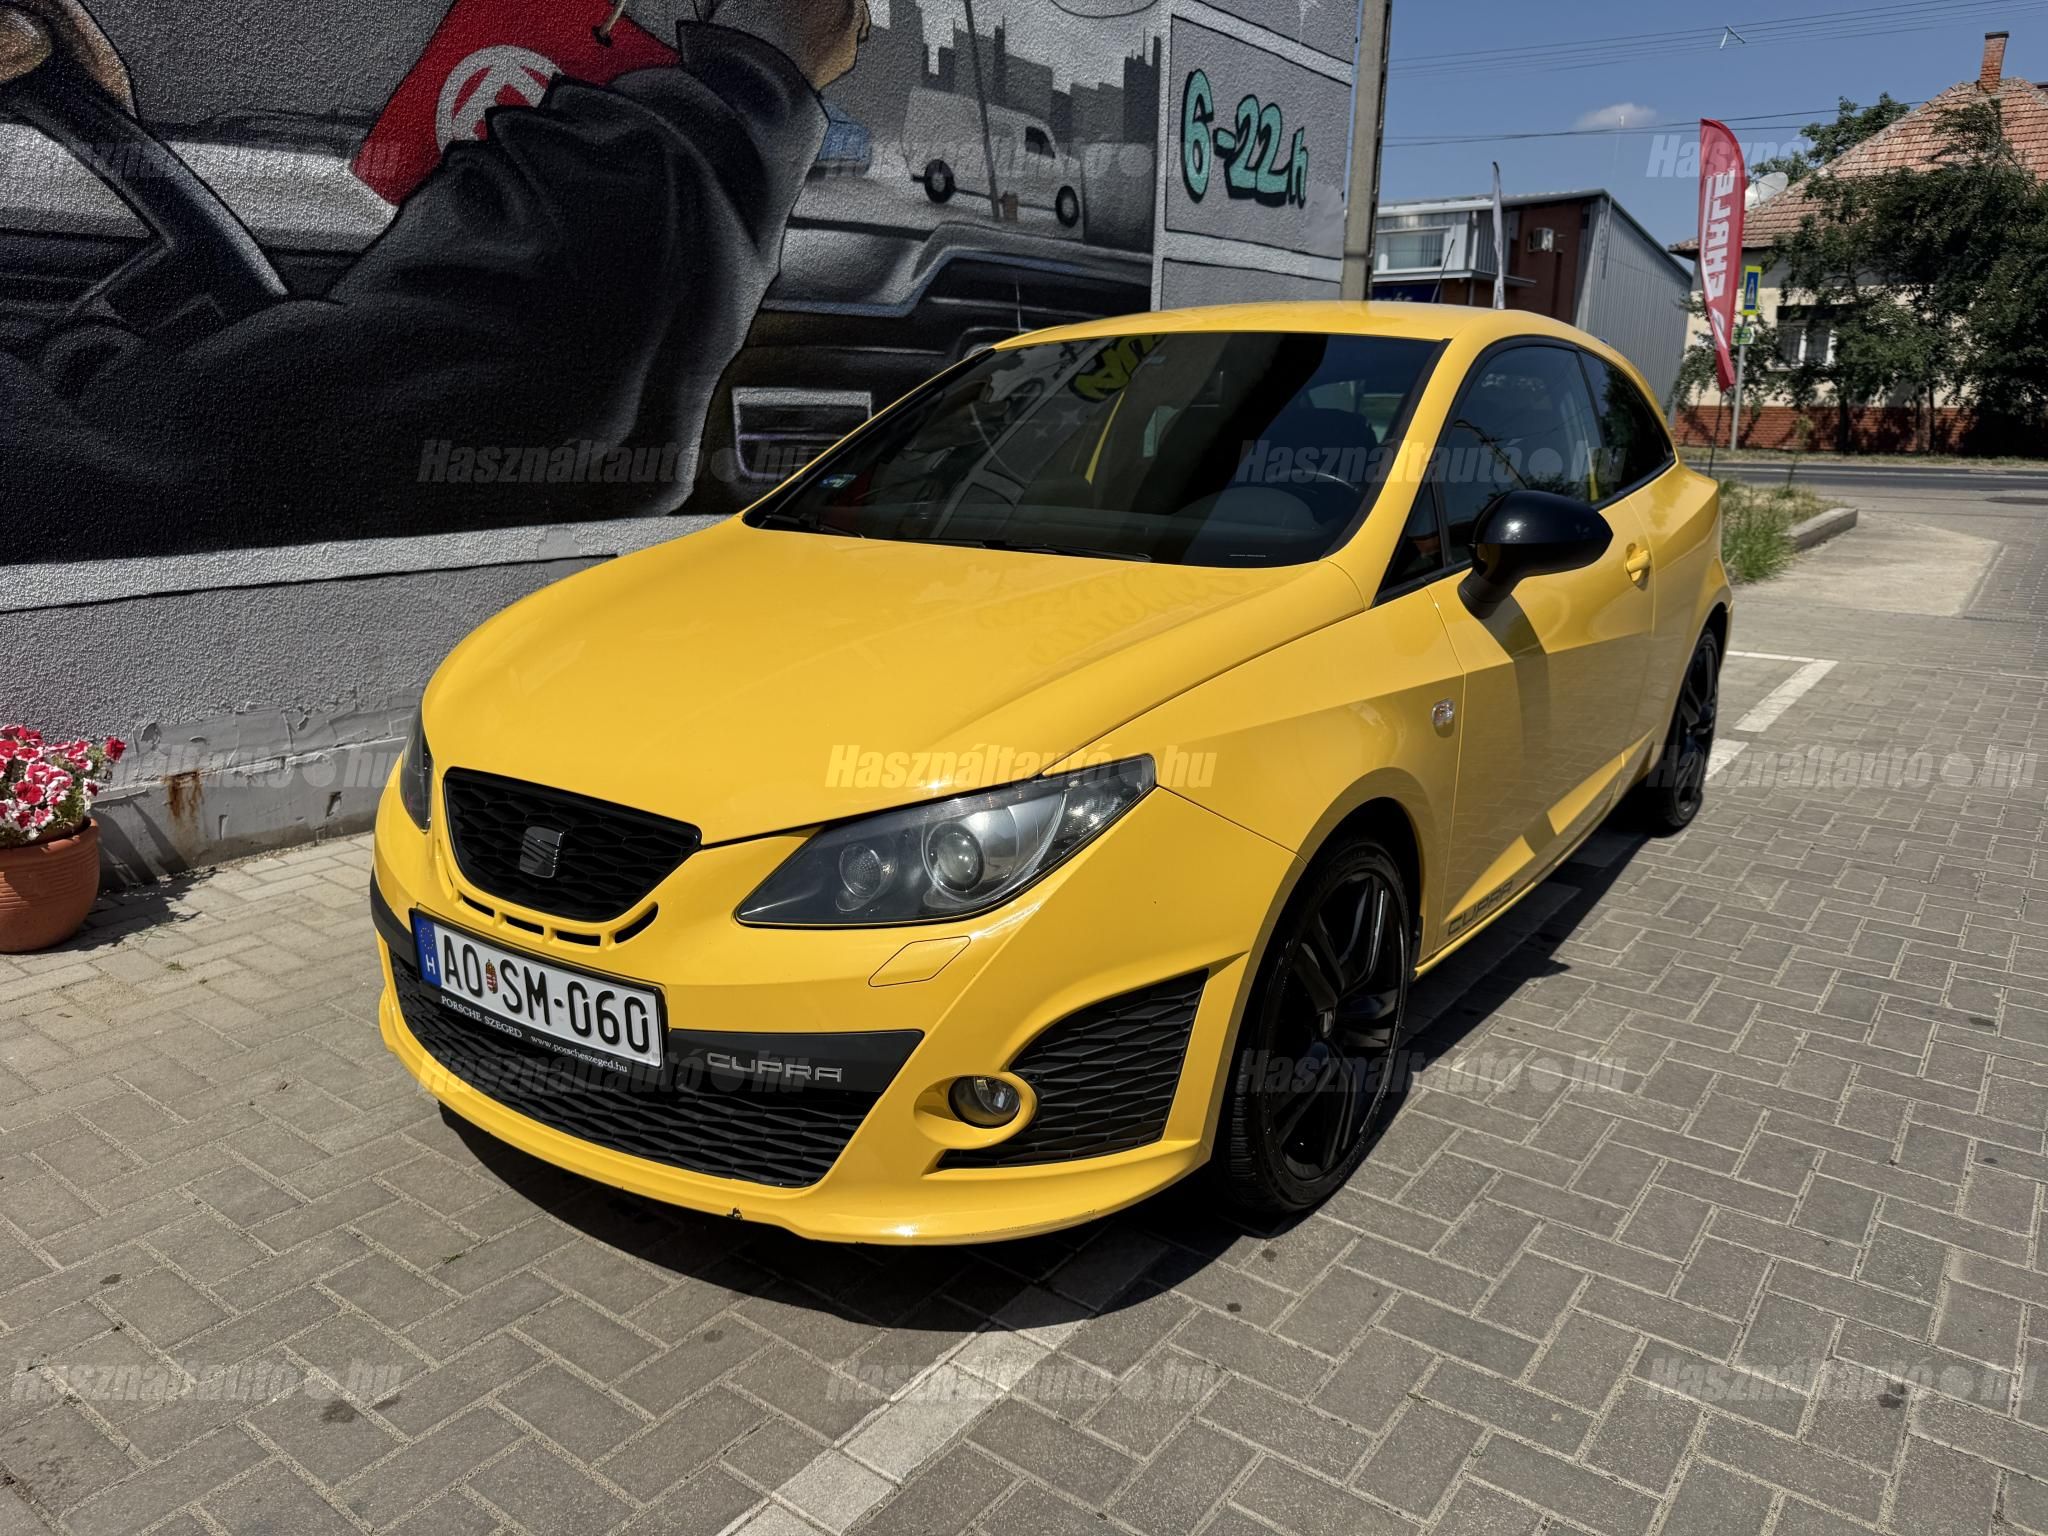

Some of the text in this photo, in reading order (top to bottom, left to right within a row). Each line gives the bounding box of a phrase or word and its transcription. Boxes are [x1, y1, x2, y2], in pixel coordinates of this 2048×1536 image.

[1180, 68, 1309, 209] 6-22h
[425, 954, 436, 976] H
[441, 995, 628, 1074] PORSCHE SZEGED www.porscheszeged.hu
[706, 1051, 843, 1083] CUPRA
